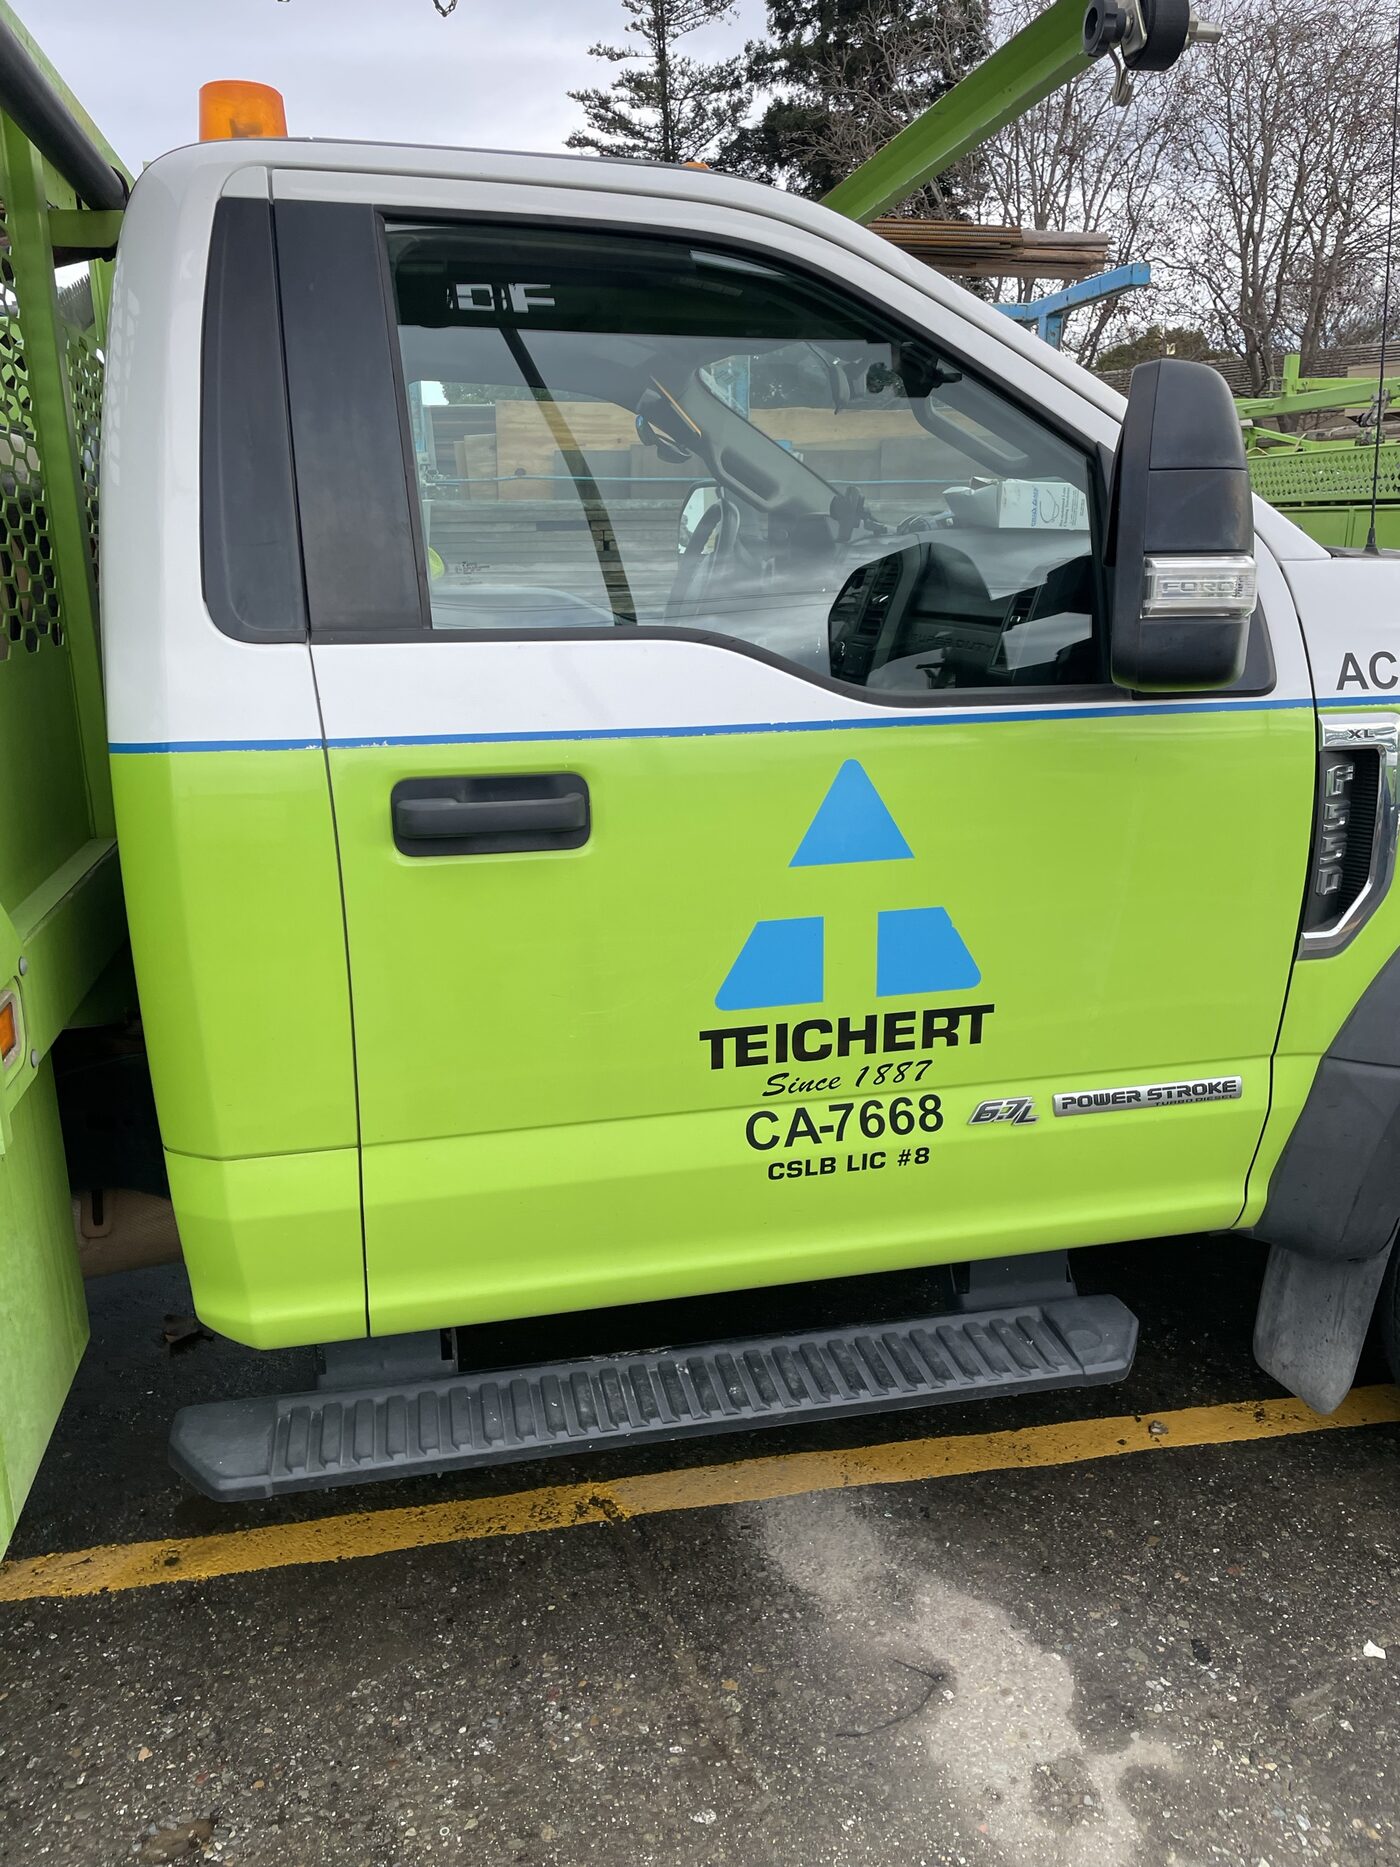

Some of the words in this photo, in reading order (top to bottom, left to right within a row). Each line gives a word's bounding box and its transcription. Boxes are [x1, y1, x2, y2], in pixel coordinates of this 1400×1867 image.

[1347, 728, 1375, 739] XL
[699, 1004, 995, 1070] TEICHERT
[761, 1072, 842, 1097] Since
[853, 1059, 934, 1090] 1887
[1061, 1089, 1142, 1110] POWER
[1147, 1079, 1238, 1102] STROKE
[745, 1094, 944, 1151] CA-7668
[768, 1155, 837, 1181] CSLB
[846, 1150, 888, 1173] LIC
[897, 1146, 930, 1167] #8
